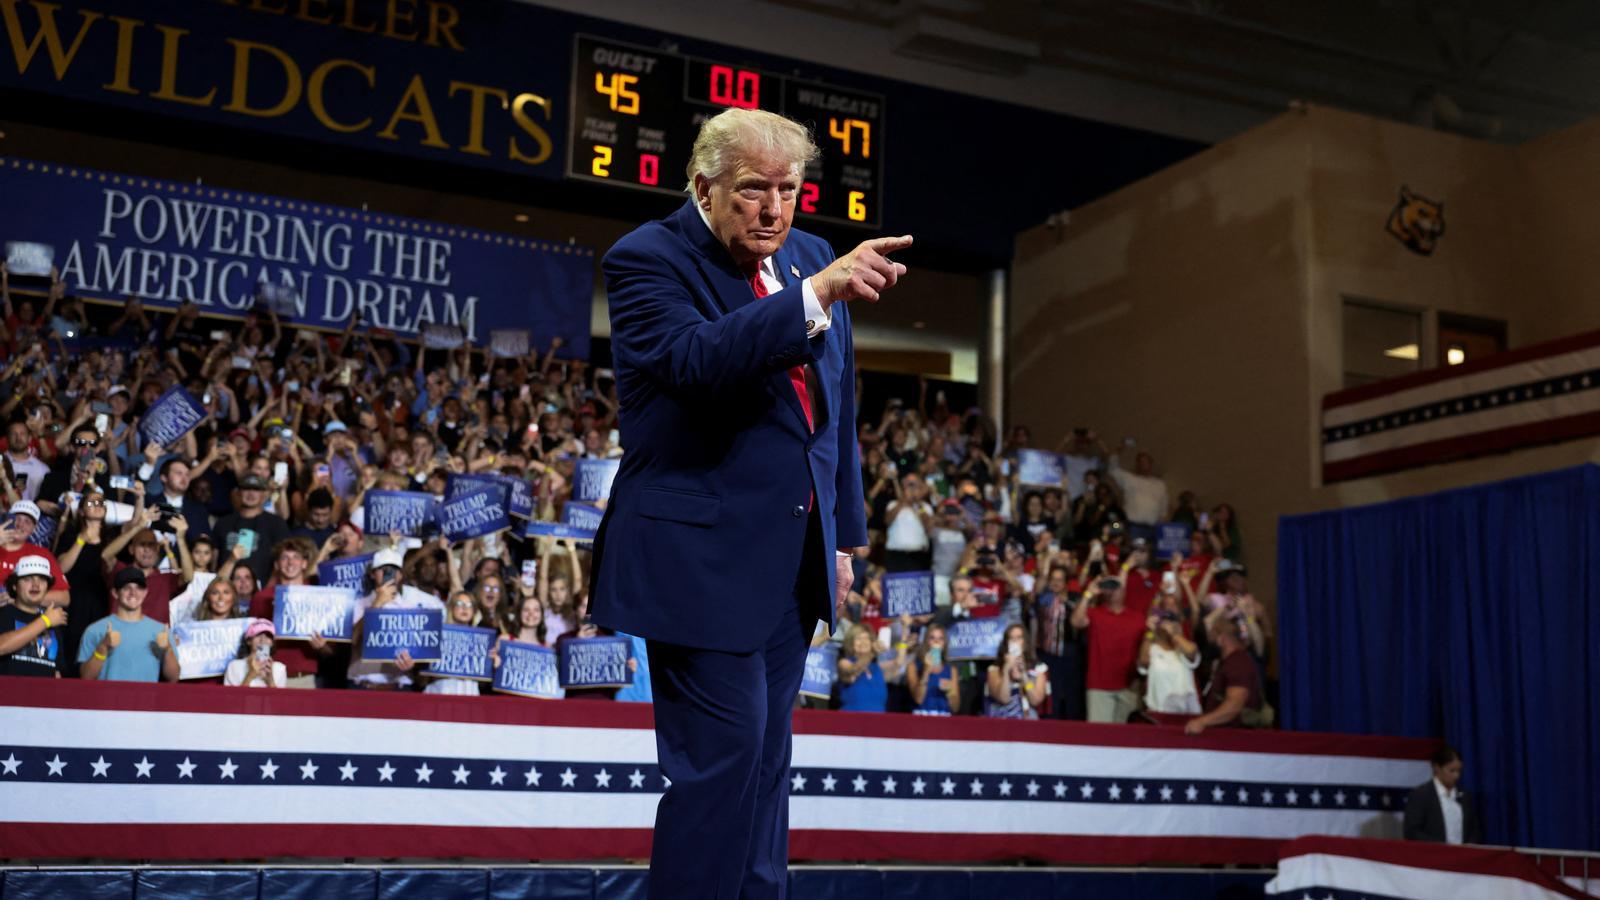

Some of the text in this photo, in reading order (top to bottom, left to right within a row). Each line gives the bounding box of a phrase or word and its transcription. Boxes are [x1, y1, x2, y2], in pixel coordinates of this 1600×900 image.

[216, 0, 466, 52] ELER
[593, 47, 657, 74] GUEST
[0, 0, 554, 166] WILDCATS
[595, 71, 640, 115] 45
[797, 87, 879, 119] WILDCATS
[829, 117, 871, 158] 47
[592, 145, 613, 177] 2
[639, 153, 659, 186] 0
[800, 181, 820, 214] 2
[848, 190, 866, 222] 6
[101, 188, 452, 288] POWERING THE
[322, 274, 478, 342] DREAM
[441, 502, 505, 535] ACCOUNTS
[444, 492, 488, 520] TRUMP
[334, 561, 368, 580] TRU
[190, 625, 241, 645] TRUMP
[281, 614, 345, 638] DREAM
[379, 614, 429, 631] TRUMP
[366, 630, 439, 648] ACCOUNTS
[440, 637, 489, 657] MERICAN
[500, 667, 558, 696] DREAM
[568, 664, 626, 684] DREAM
